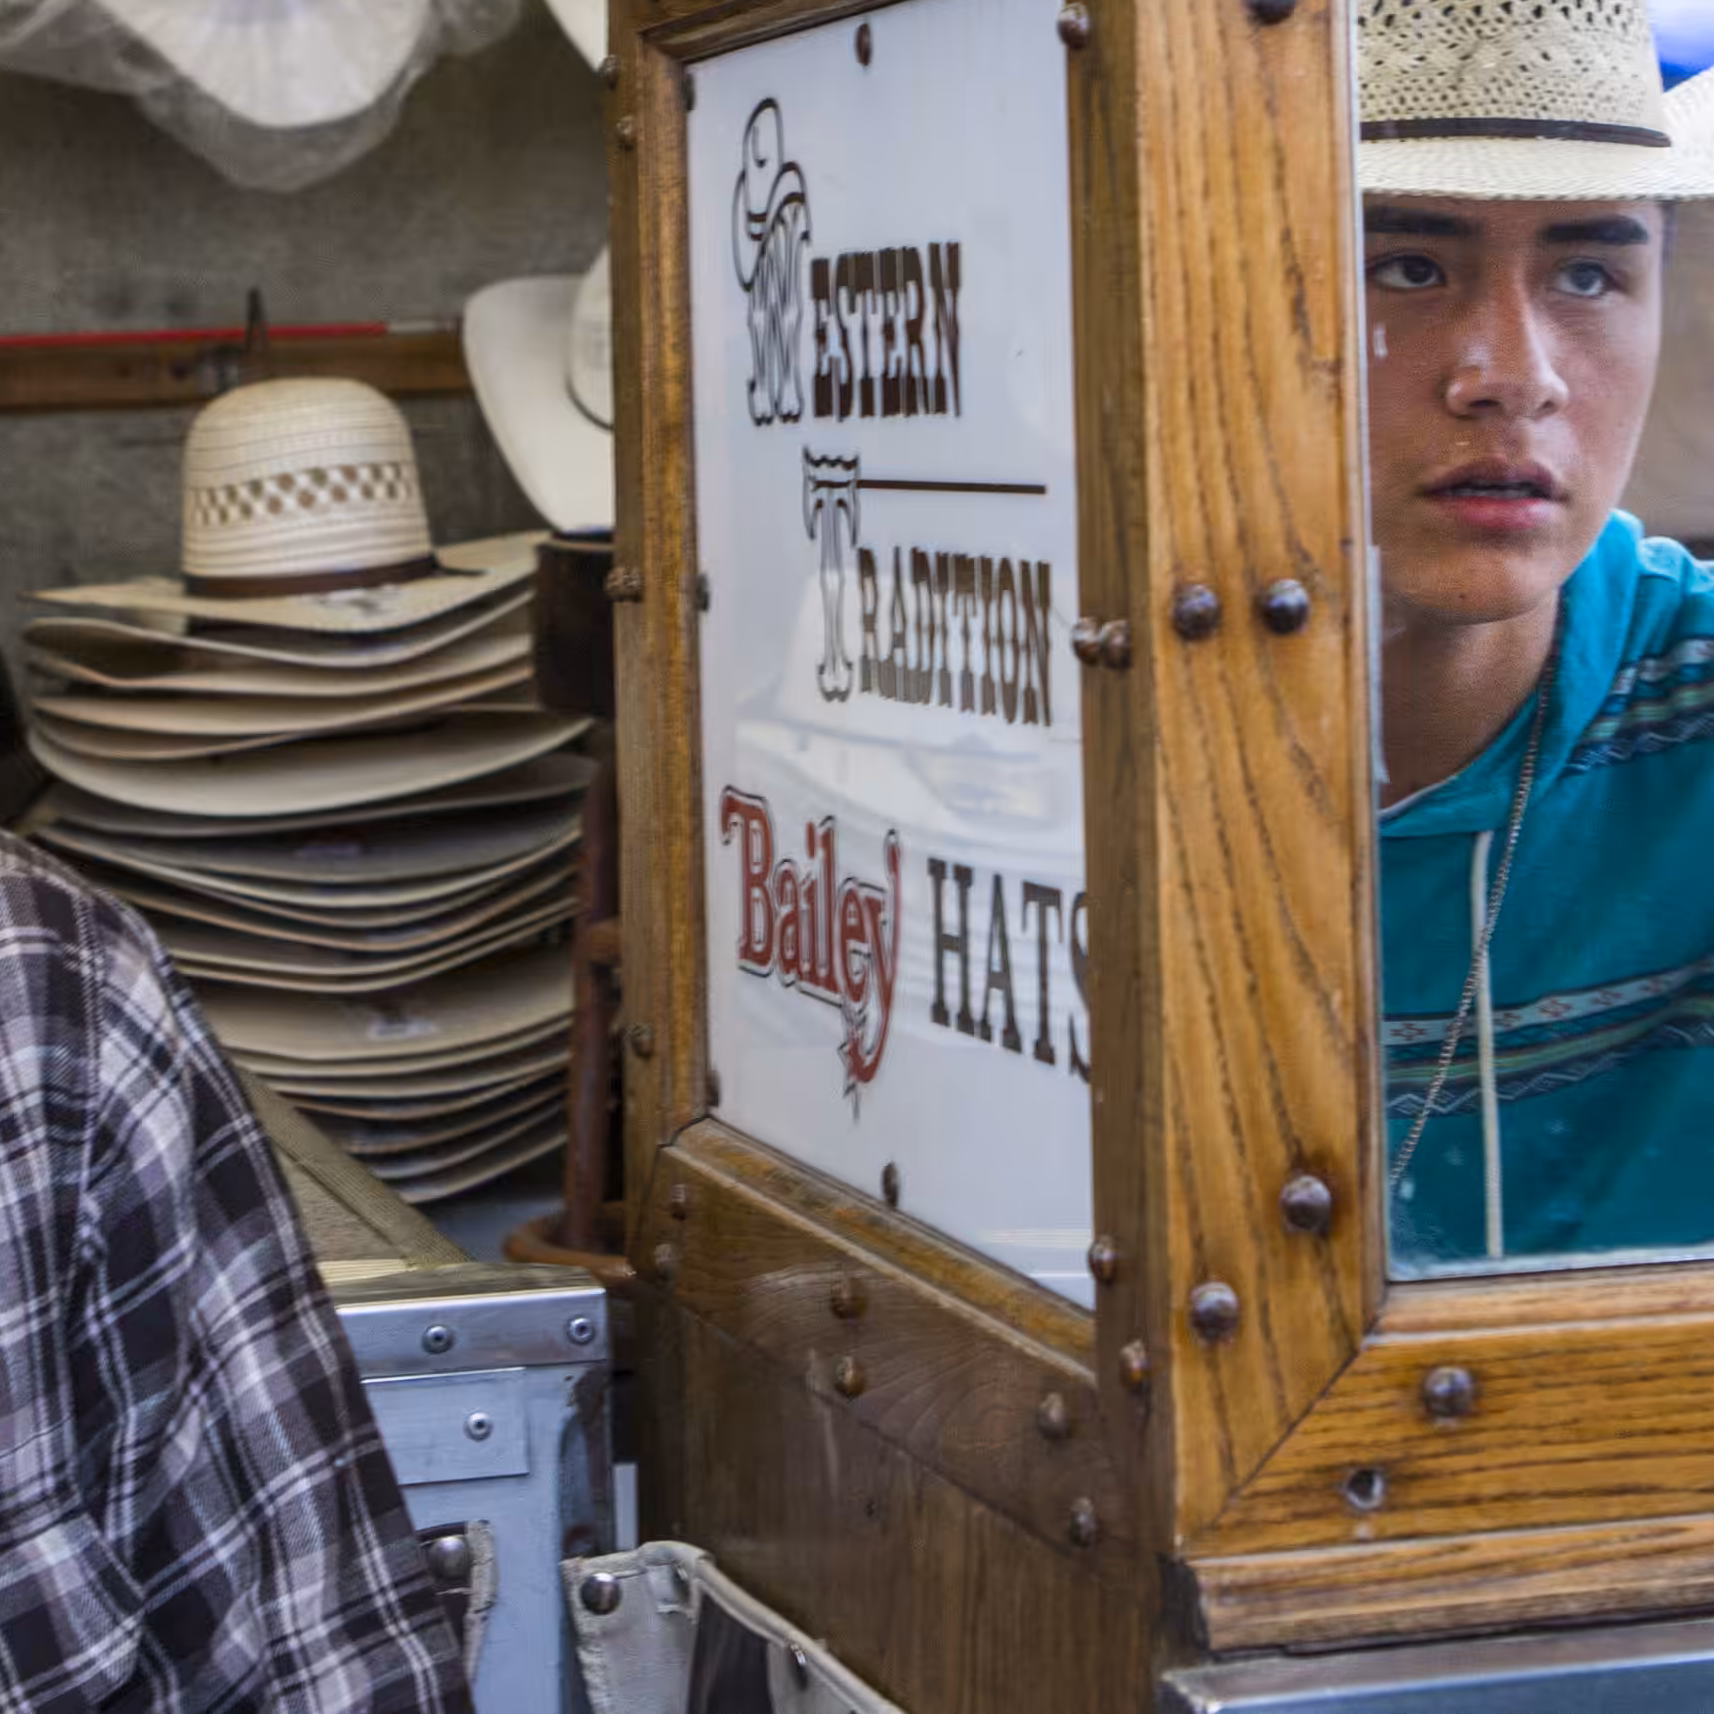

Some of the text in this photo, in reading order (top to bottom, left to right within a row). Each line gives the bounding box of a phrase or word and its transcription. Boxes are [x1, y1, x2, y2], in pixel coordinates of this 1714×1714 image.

[746, 186, 962, 426] WESTERN
[802, 446, 1052, 726] TRADITION
[720, 785, 901, 1096] Bailey
